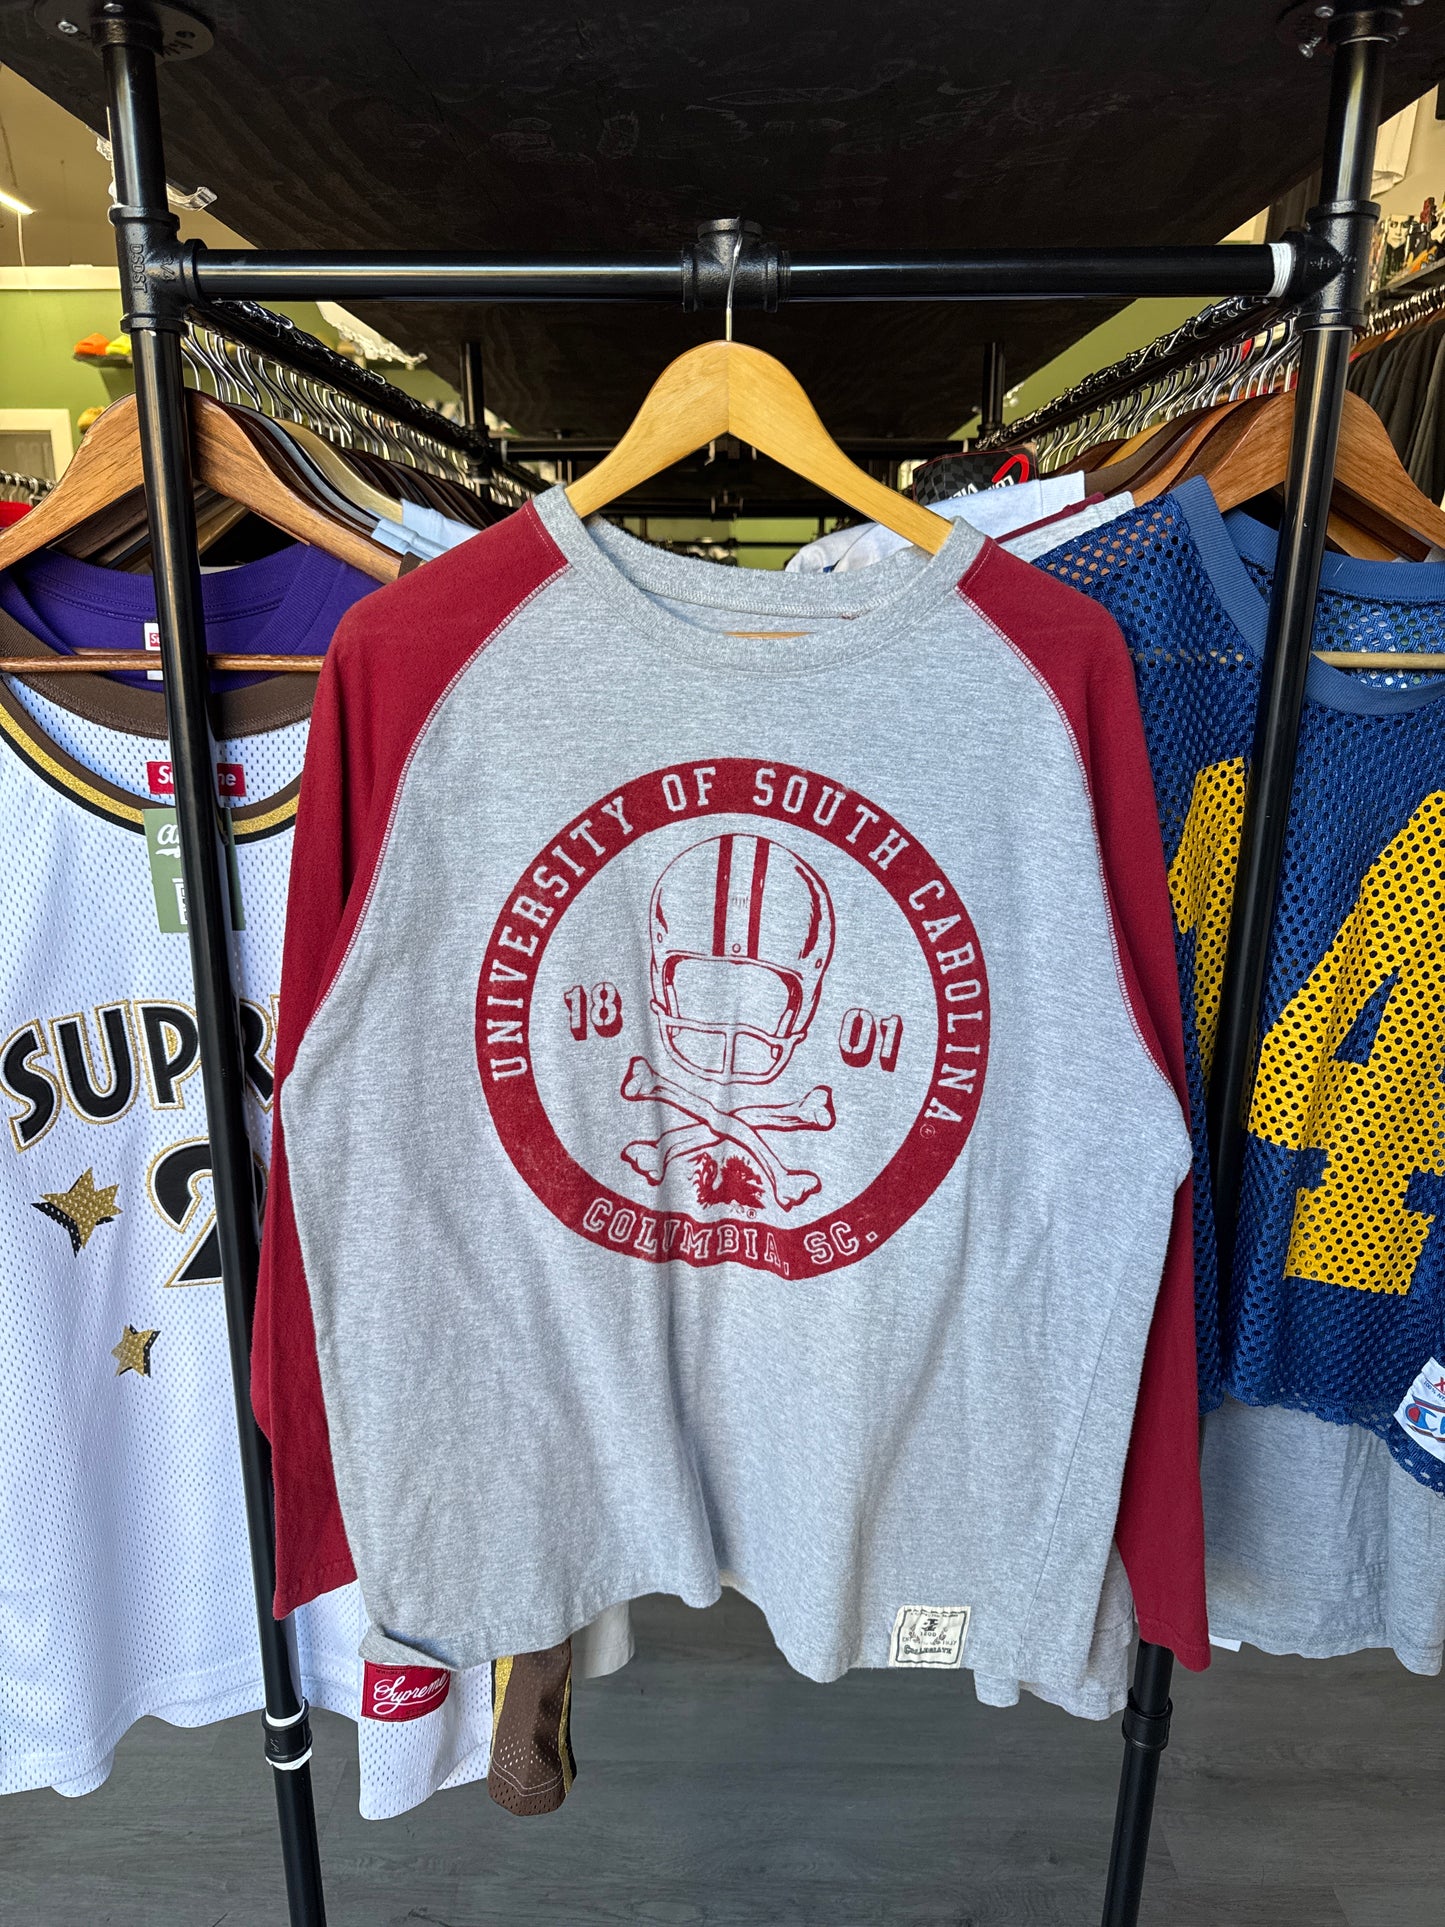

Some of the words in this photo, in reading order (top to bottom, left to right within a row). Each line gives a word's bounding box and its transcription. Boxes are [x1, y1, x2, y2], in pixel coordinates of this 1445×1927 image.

[487, 803, 634, 1081] UNIVERSITY
[662, 767, 717, 811] OF
[753, 768, 910, 870] SOUTH
[908, 879, 984, 1127] CAROLINA
[563, 981, 624, 1041] 18
[837, 1007, 903, 1073] 01
[0, 995, 281, 1153] SUPR
[583, 1197, 790, 1276] COLUMBIA,
[803, 1220, 879, 1265] SC.
[372, 1673, 450, 1716] Supreme
